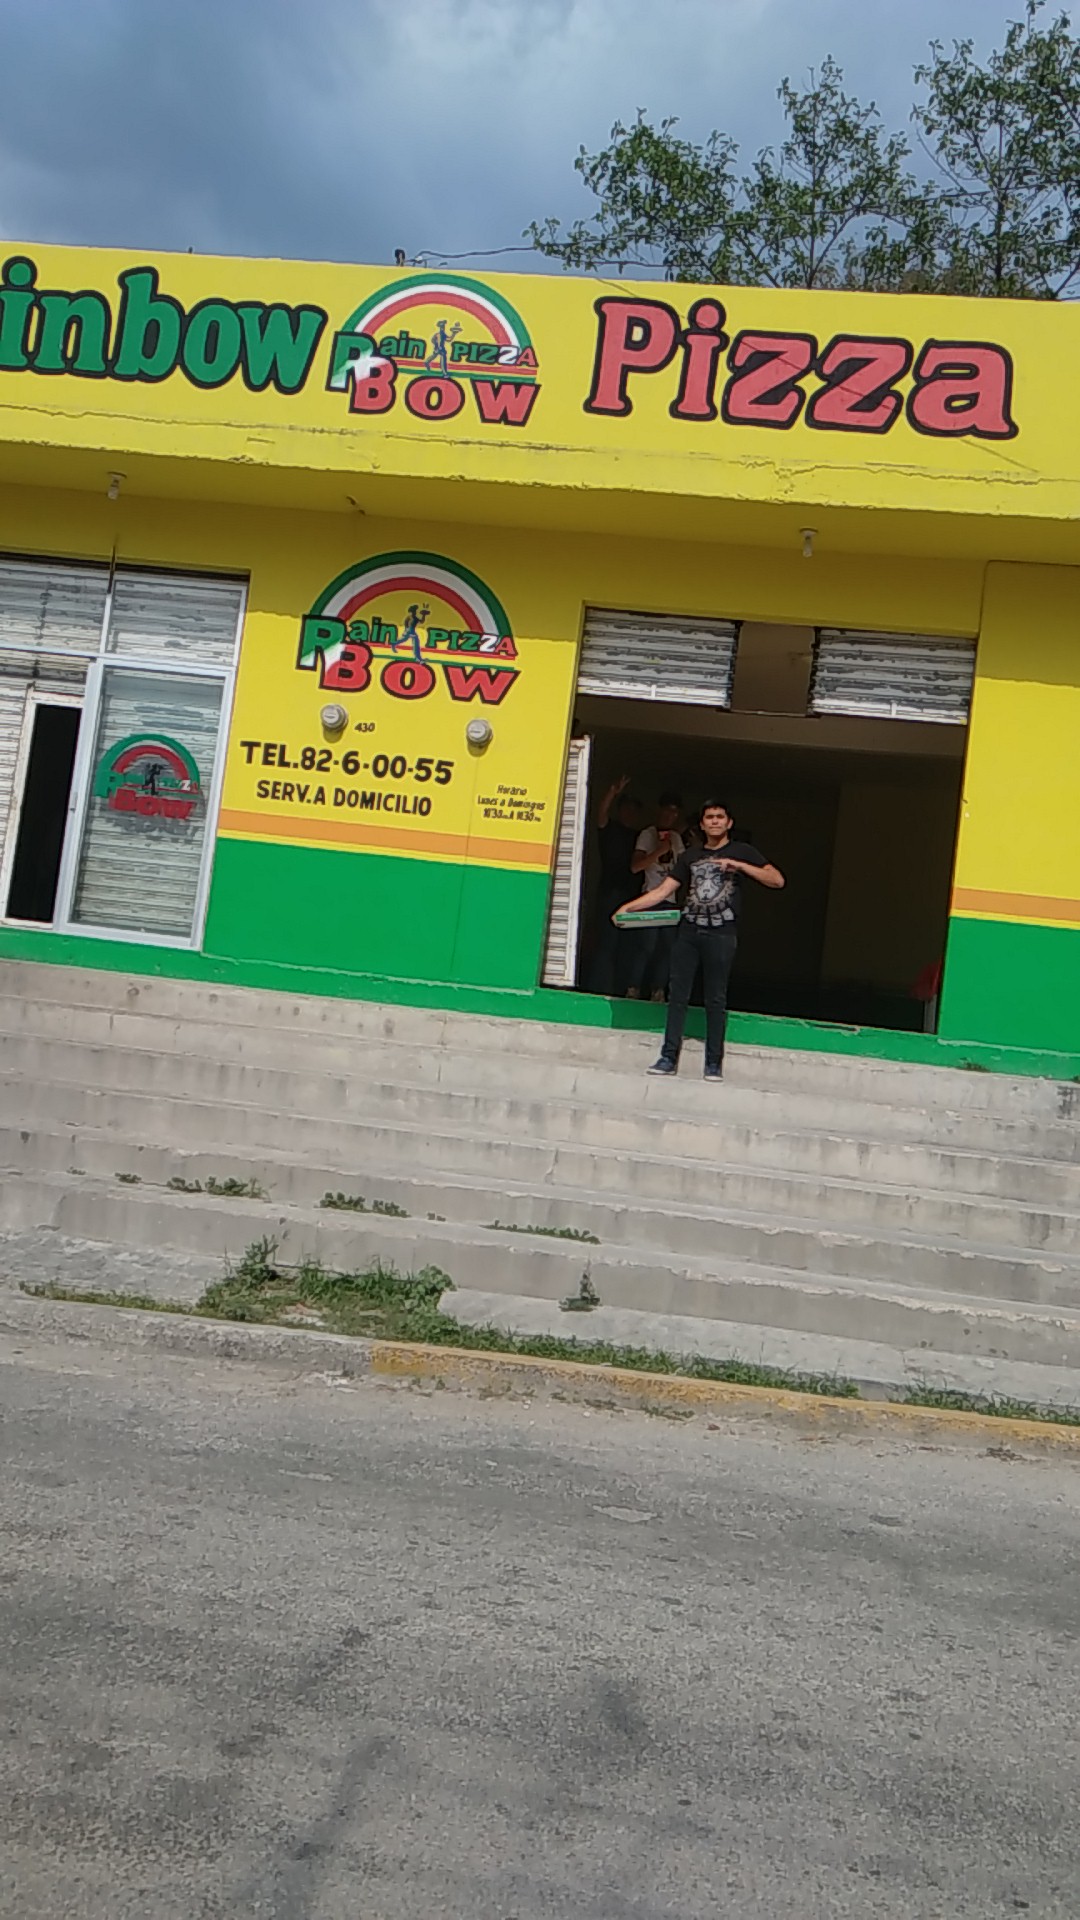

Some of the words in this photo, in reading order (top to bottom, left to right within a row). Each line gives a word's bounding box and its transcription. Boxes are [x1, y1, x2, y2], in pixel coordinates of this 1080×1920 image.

[450, 341, 539, 367] PIZZA
[583, 296, 1019, 440] Pizza
[348, 357, 542, 428] BOW
[426, 628, 518, 656] PIZZA
[318, 641, 521, 705] BOW
[354, 722, 375, 733] 430
[333, 787, 432, 817] DOMICILIO
